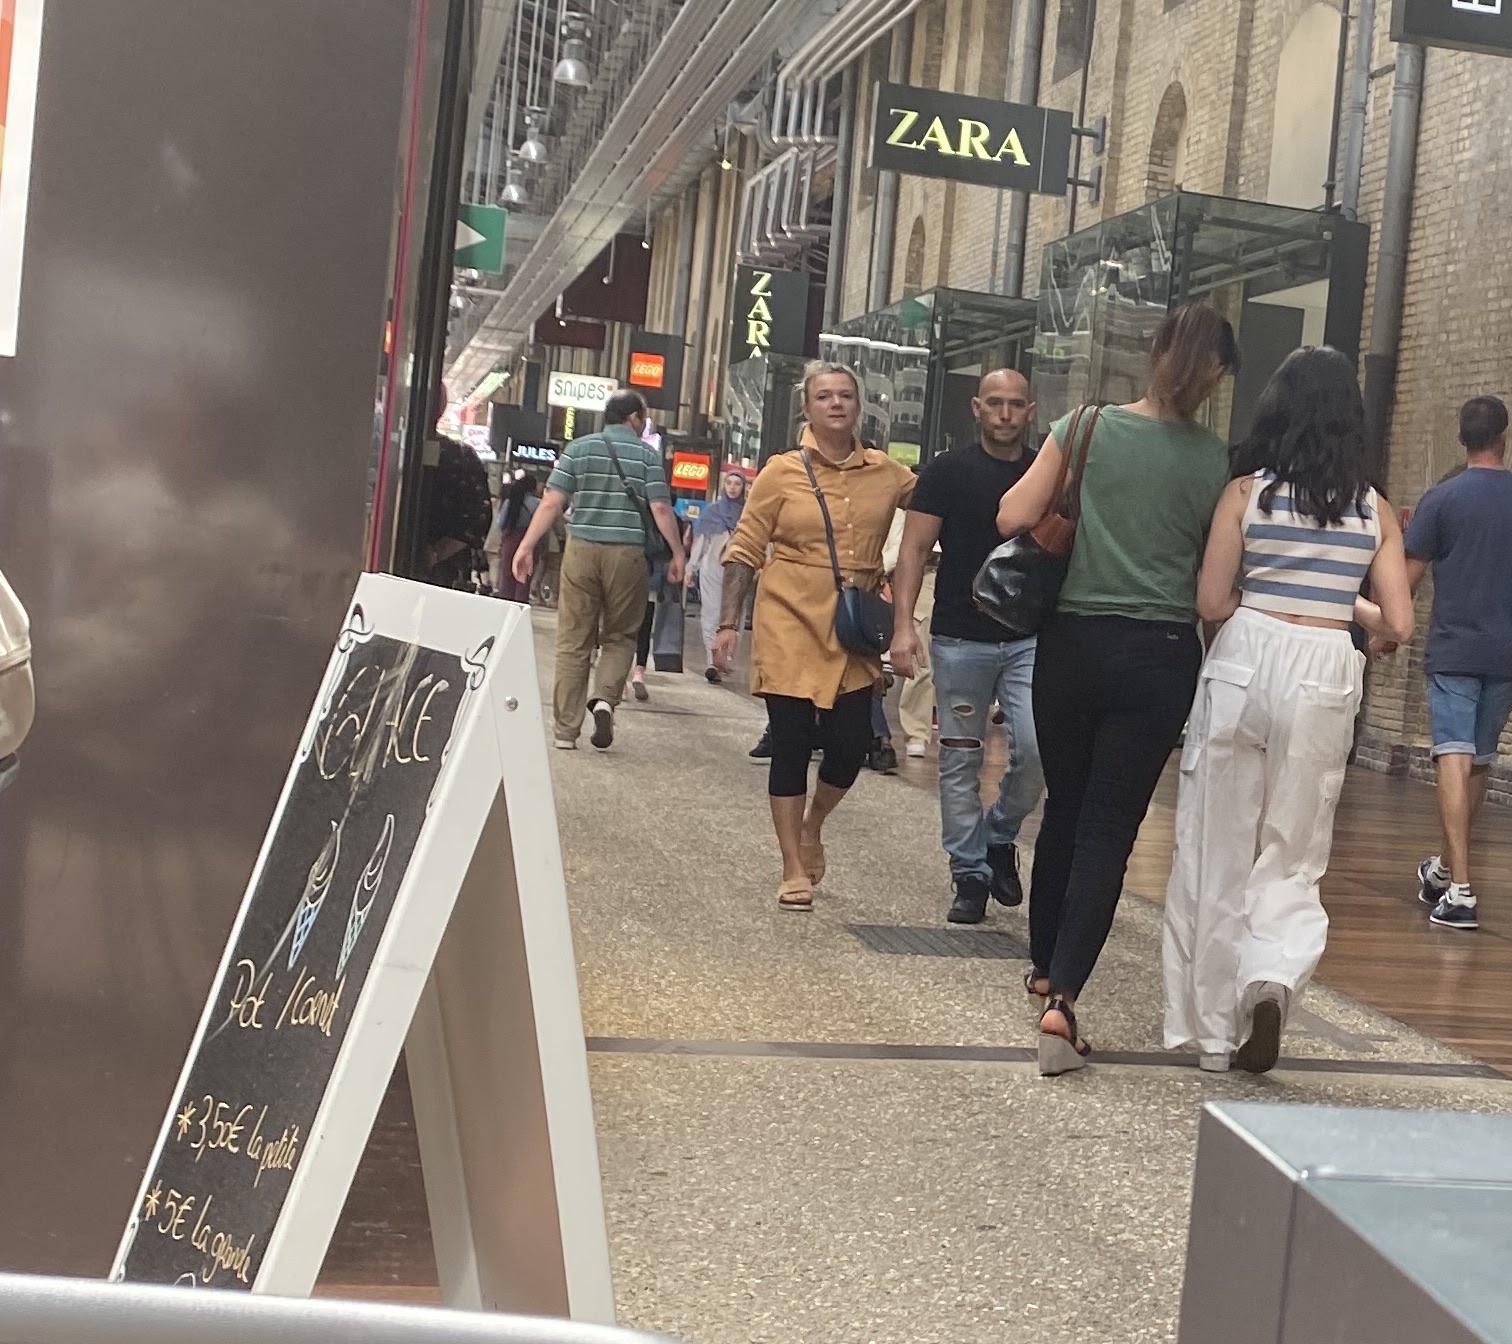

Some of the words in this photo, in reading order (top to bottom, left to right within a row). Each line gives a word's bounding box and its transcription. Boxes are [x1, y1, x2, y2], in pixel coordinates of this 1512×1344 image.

[885, 108, 1031, 166] ZARA
[632, 361, 662, 377] LEGO
[554, 378, 606, 401] snipes
[512, 444, 557, 461] JULES
[673, 461, 708, 480] LEGO
